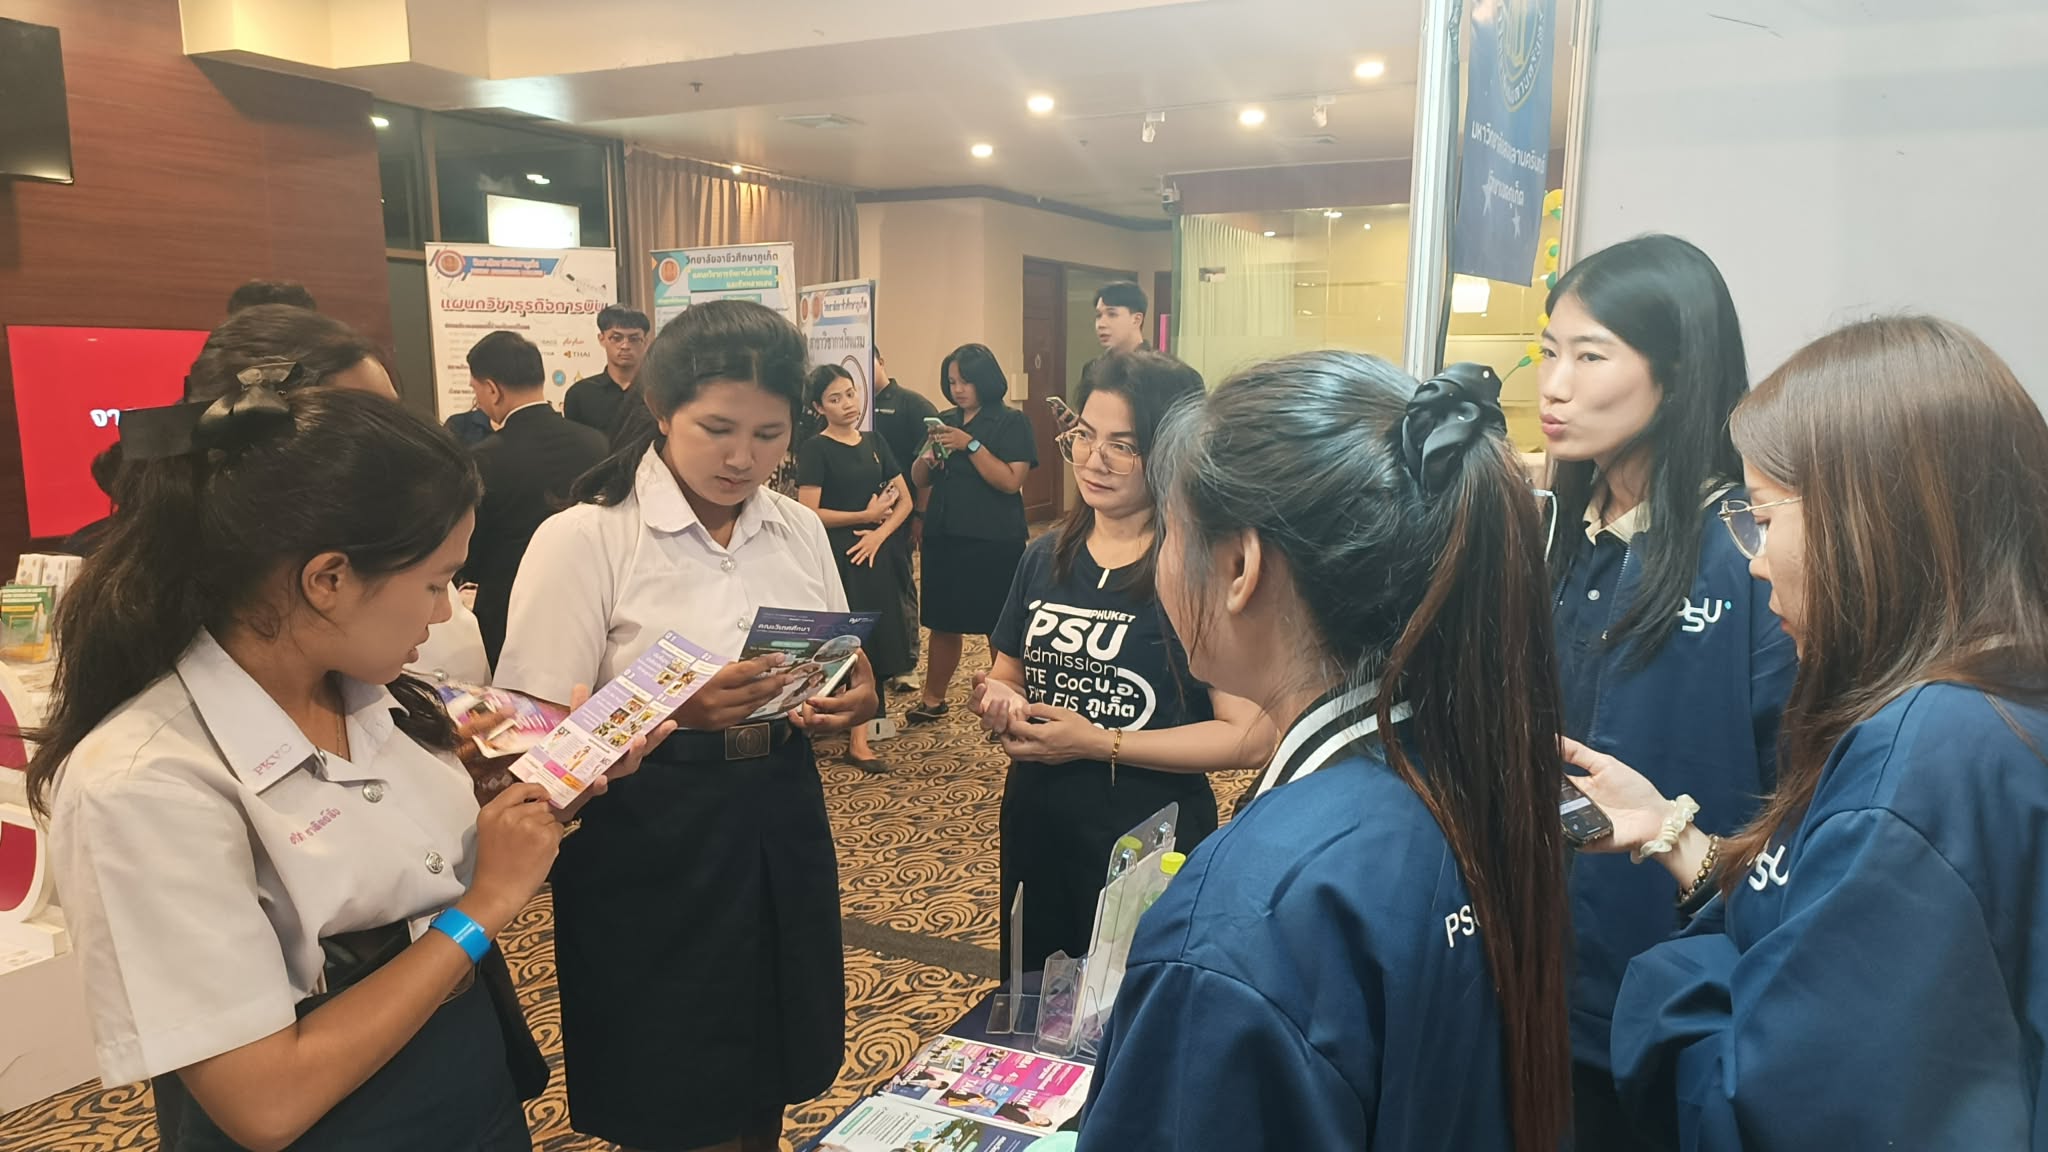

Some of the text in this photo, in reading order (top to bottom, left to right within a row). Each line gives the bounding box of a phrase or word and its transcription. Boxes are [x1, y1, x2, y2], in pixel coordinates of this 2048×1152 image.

[1090, 609, 1136, 622] PHUKET
[1025, 609, 1128, 661] PSU
[1023, 646, 1117, 678] Admission
[1025, 665, 1093, 693] FTE CoC
[1085, 696, 1136, 718] ภูเก็ต
